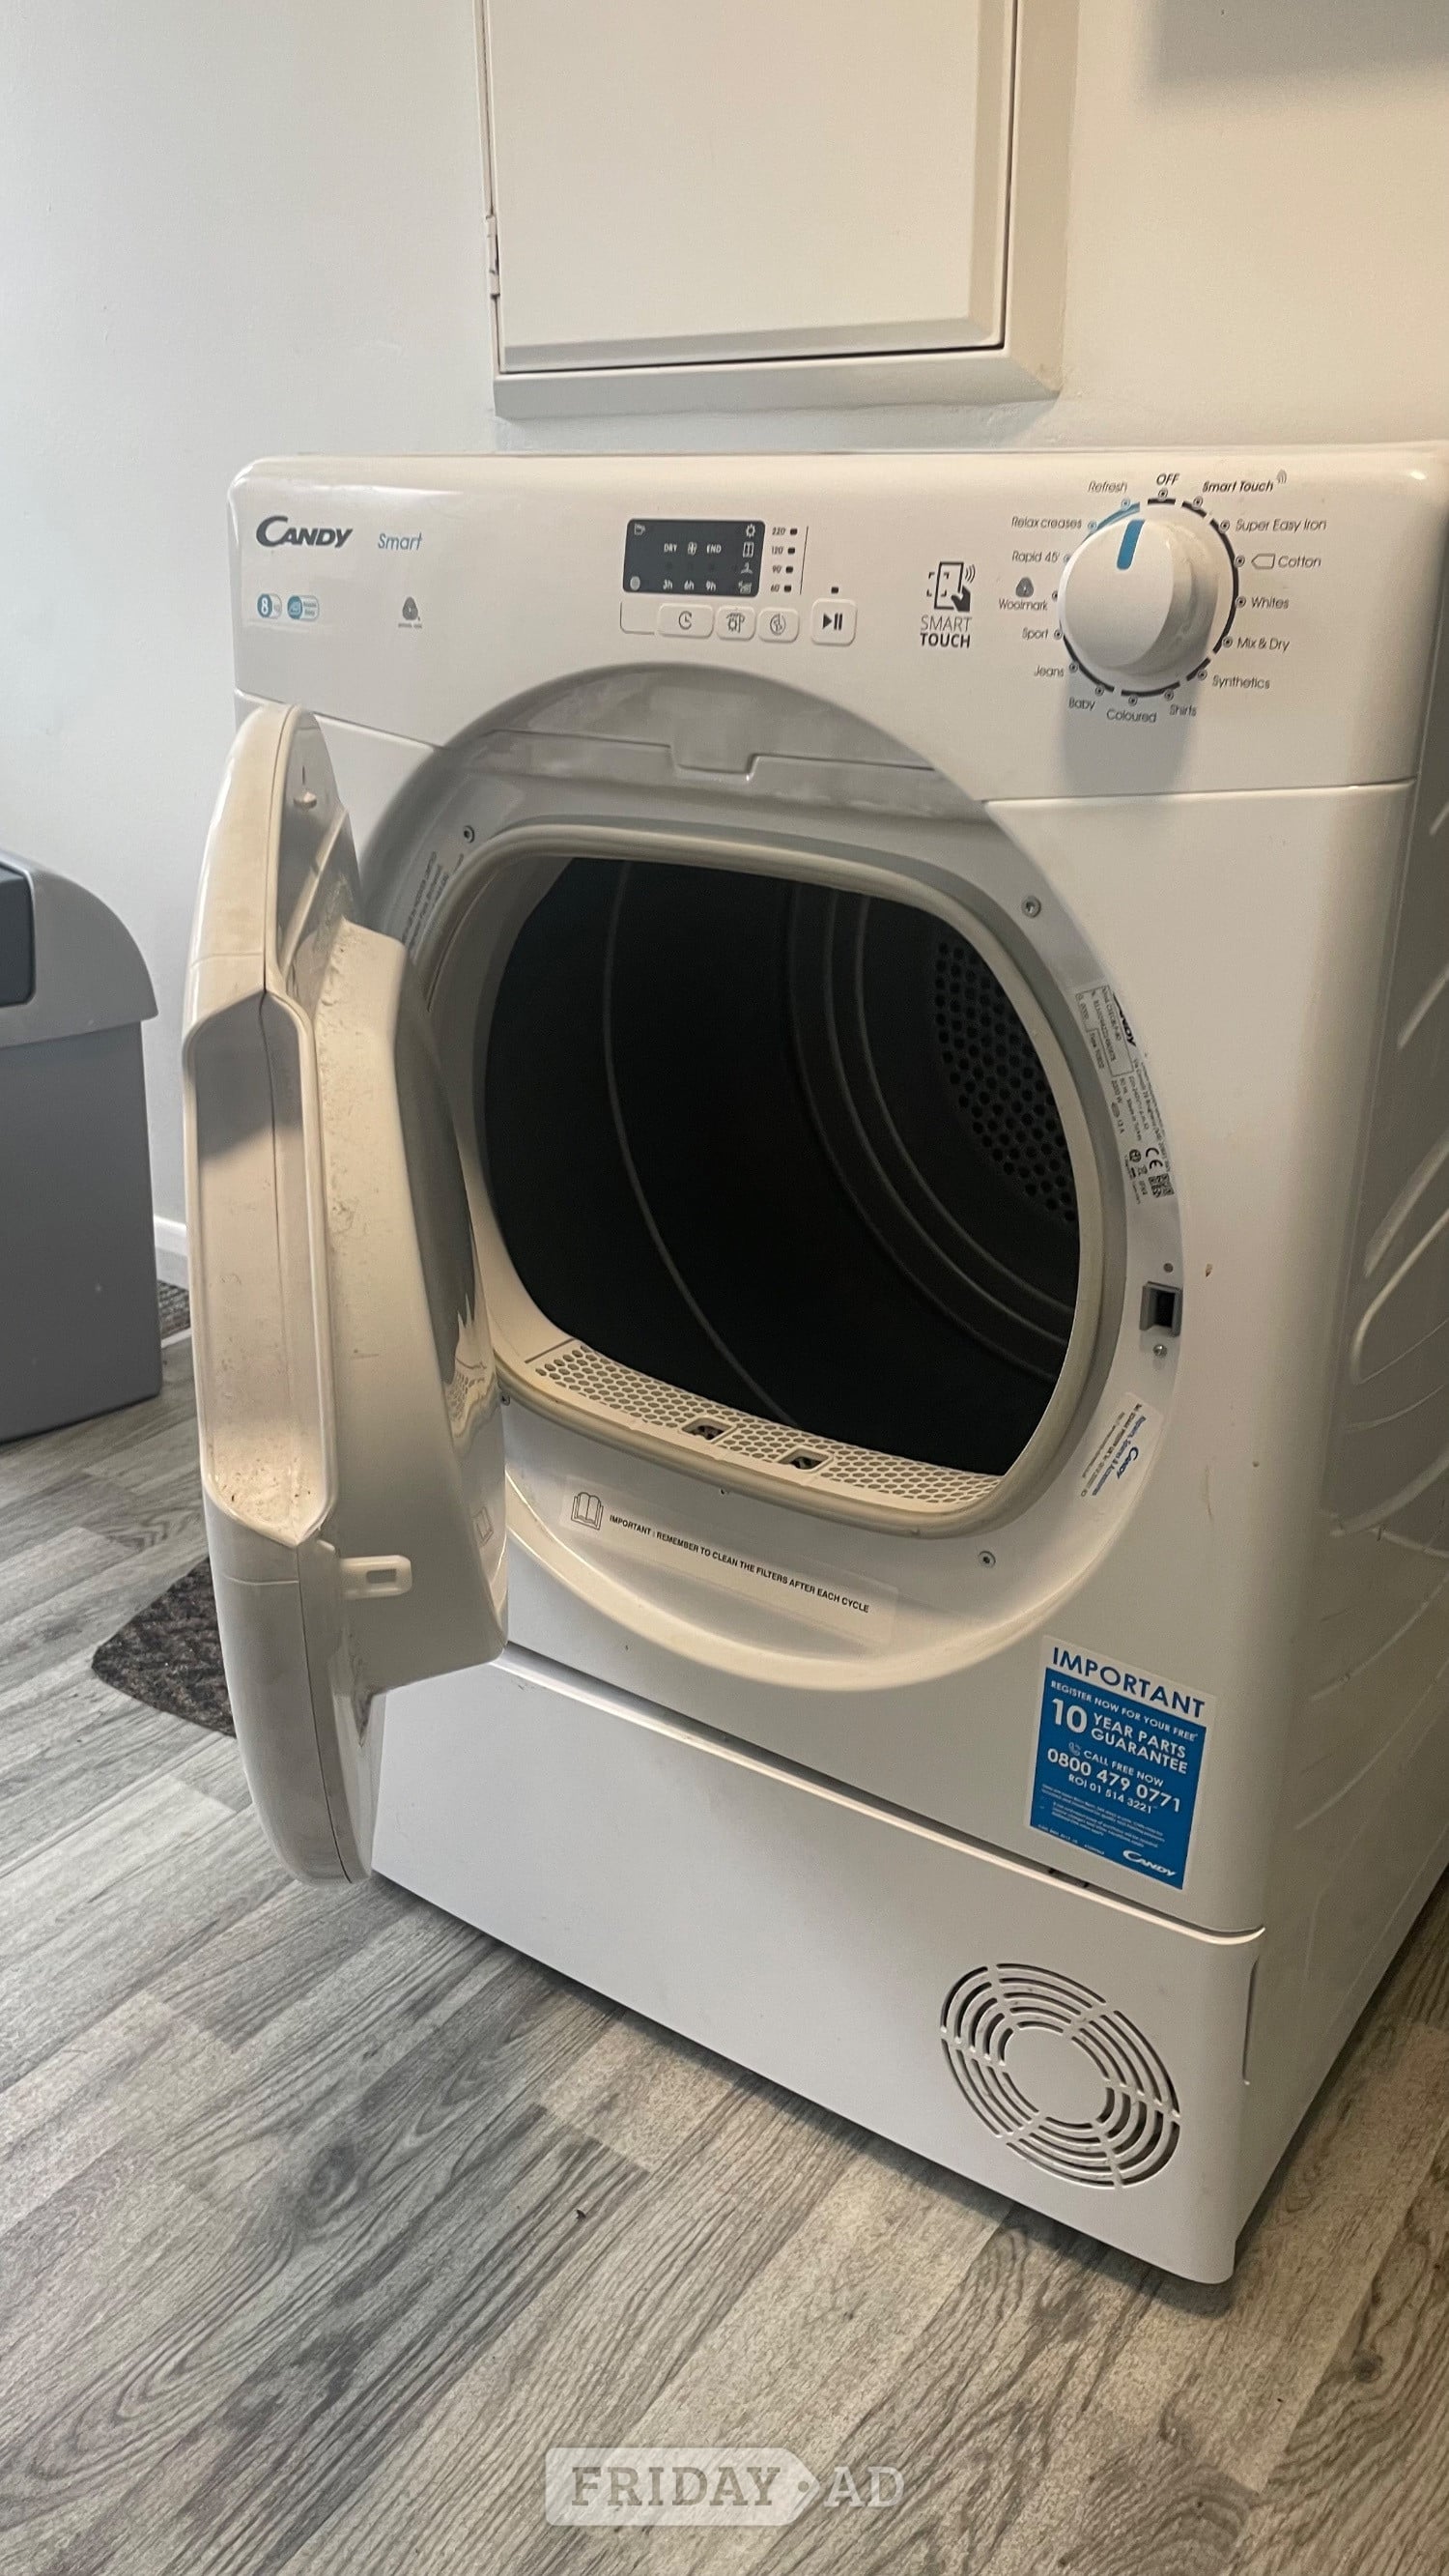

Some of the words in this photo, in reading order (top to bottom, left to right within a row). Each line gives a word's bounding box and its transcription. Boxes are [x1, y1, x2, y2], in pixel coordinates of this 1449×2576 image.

[1155, 472, 1179, 485] OFF
[1088, 481, 1127, 494] Refresh
[1202, 480, 1236, 493] Smart
[1239, 482, 1274, 493] Touch
[1011, 516, 1039, 529] Relax
[1040, 519, 1082, 530] creases
[1236, 520, 1269, 532] Super
[1273, 520, 1302, 532] Easy
[1304, 519, 1327, 530] Iron
[256, 515, 354, 548] CANDY
[378, 532, 422, 551] Smart
[664, 543, 677, 553] DRY
[706, 544, 722, 554] END
[1011, 551, 1041, 563] Rapid
[1277, 556, 1321, 568] Cotton
[261, 597, 269, 615] 8
[998, 598, 1048, 612] Woolmark
[1251, 597, 1290, 610] Whites
[921, 615, 973, 633] SMART
[920, 633, 971, 648] TOUCH
[1022, 628, 1049, 640] Sport
[1237, 637, 1257, 649] Mix
[1259, 638, 1267, 649] &
[1268, 638, 1291, 652] Dry
[1034, 666, 1065, 677] Jeans
[1211, 675, 1270, 690] Synthetics
[1068, 698, 1095, 711] Baby
[1169, 704, 1197, 717] Shirts
[1106, 709, 1157, 723] Coloured
[610, 1515, 651, 1535] IMPORTANT
[656, 1531, 699, 1554] REMEMBER
[700, 1546, 711, 1558] TO
[712, 1550, 738, 1566] CLEAN
[740, 1560, 755, 1573] THE
[756, 1566, 788, 1586] FILTERS
[789, 1578, 815, 1594] AFTER
[817, 1589, 840, 1603] EACH
[841, 1596, 869, 1614] CYCLE
[1052, 1646, 1205, 1718] IMPORTANT
[1051, 1680, 1092, 1703] REGISTER
[1094, 1697, 1120, 1713] NOW
[1122, 1704, 1141, 1721] FOR
[1143, 1714, 1171, 1732] YOUR
[1051, 1698, 1088, 1733] 10
[1094, 1713, 1133, 1738] YEAR
[1138, 1731, 1186, 1759] PARTS
[1091, 1728, 1188, 1775] GUARANTEE
[1084, 1750, 1108, 1767] CALL
[1112, 1760, 1134, 1777] FREE
[1137, 1770, 1164, 1788] NOW
[1047, 1748, 1092, 1777] 0800
[1096, 1769, 1130, 1790] 479
[1135, 1784, 1180, 1813] 0771
[1068, 1774, 1088, 1789] ROI
[1089, 1783, 1101, 1794] 01
[1122, 1849, 1178, 1876] CANDY
